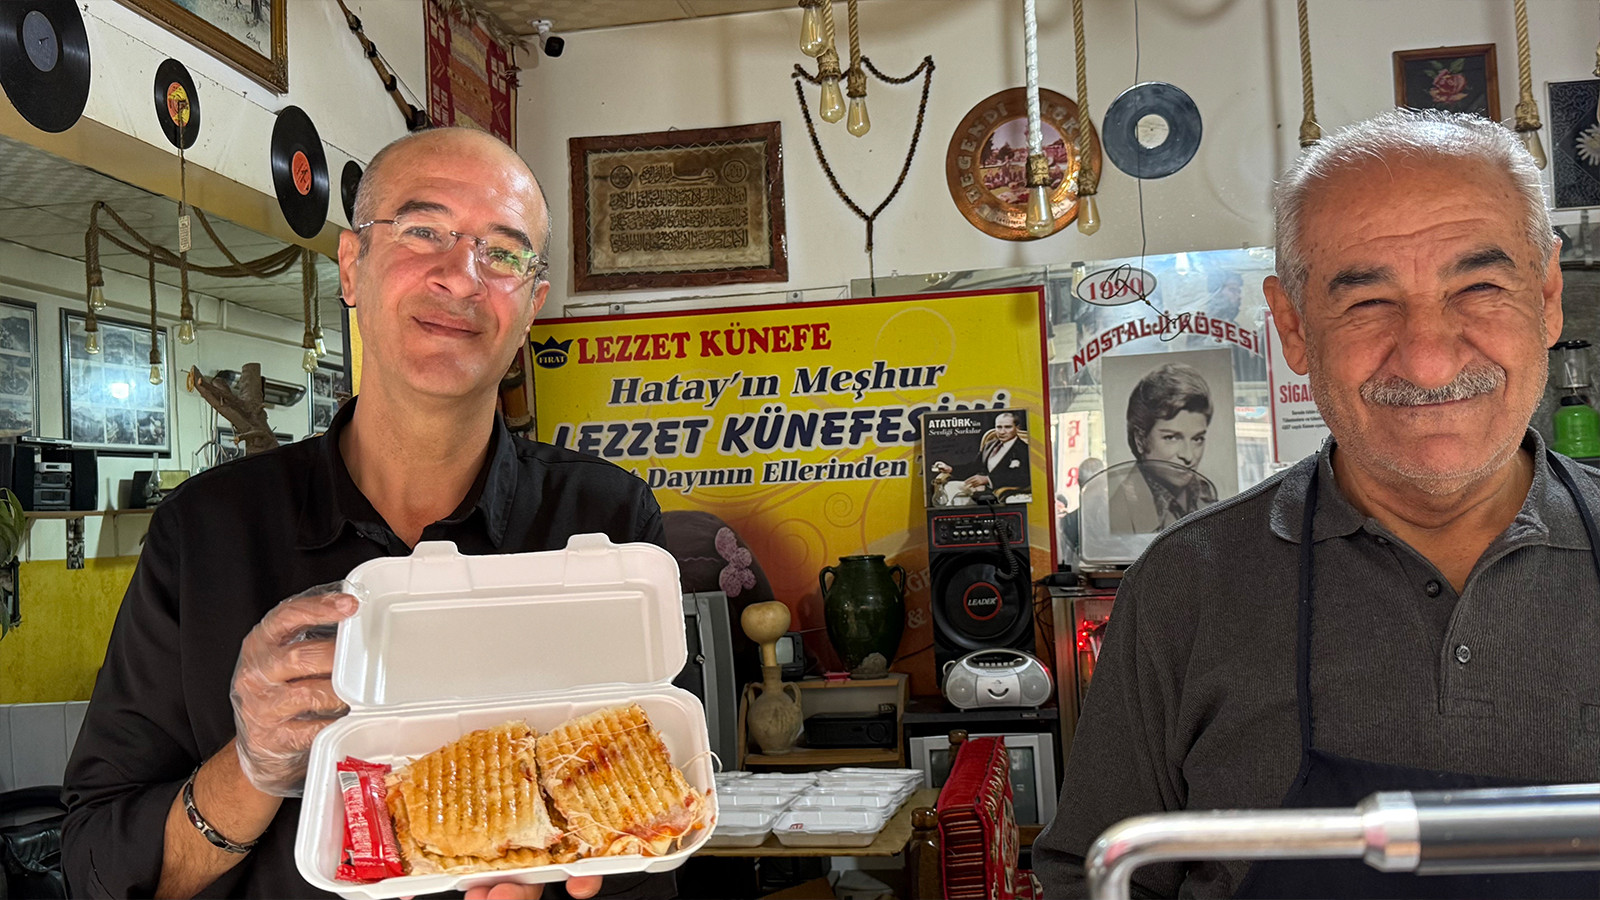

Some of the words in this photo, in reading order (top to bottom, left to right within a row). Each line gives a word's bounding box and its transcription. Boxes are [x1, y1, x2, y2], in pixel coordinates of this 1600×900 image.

[577, 331, 691, 364] LEZZET
[699, 321, 832, 358] KÜNEFE
[1072, 310, 1171, 374] NOSTALJİ
[1176, 311, 1260, 353] KÖŞESİ
[608, 371, 779, 408] Hatay'ın
[792, 361, 945, 400] Meşhur
[648, 468, 753, 494] Dayının
[762, 456, 907, 483] Ellerinden
[967, 597, 997, 606] LEADER
